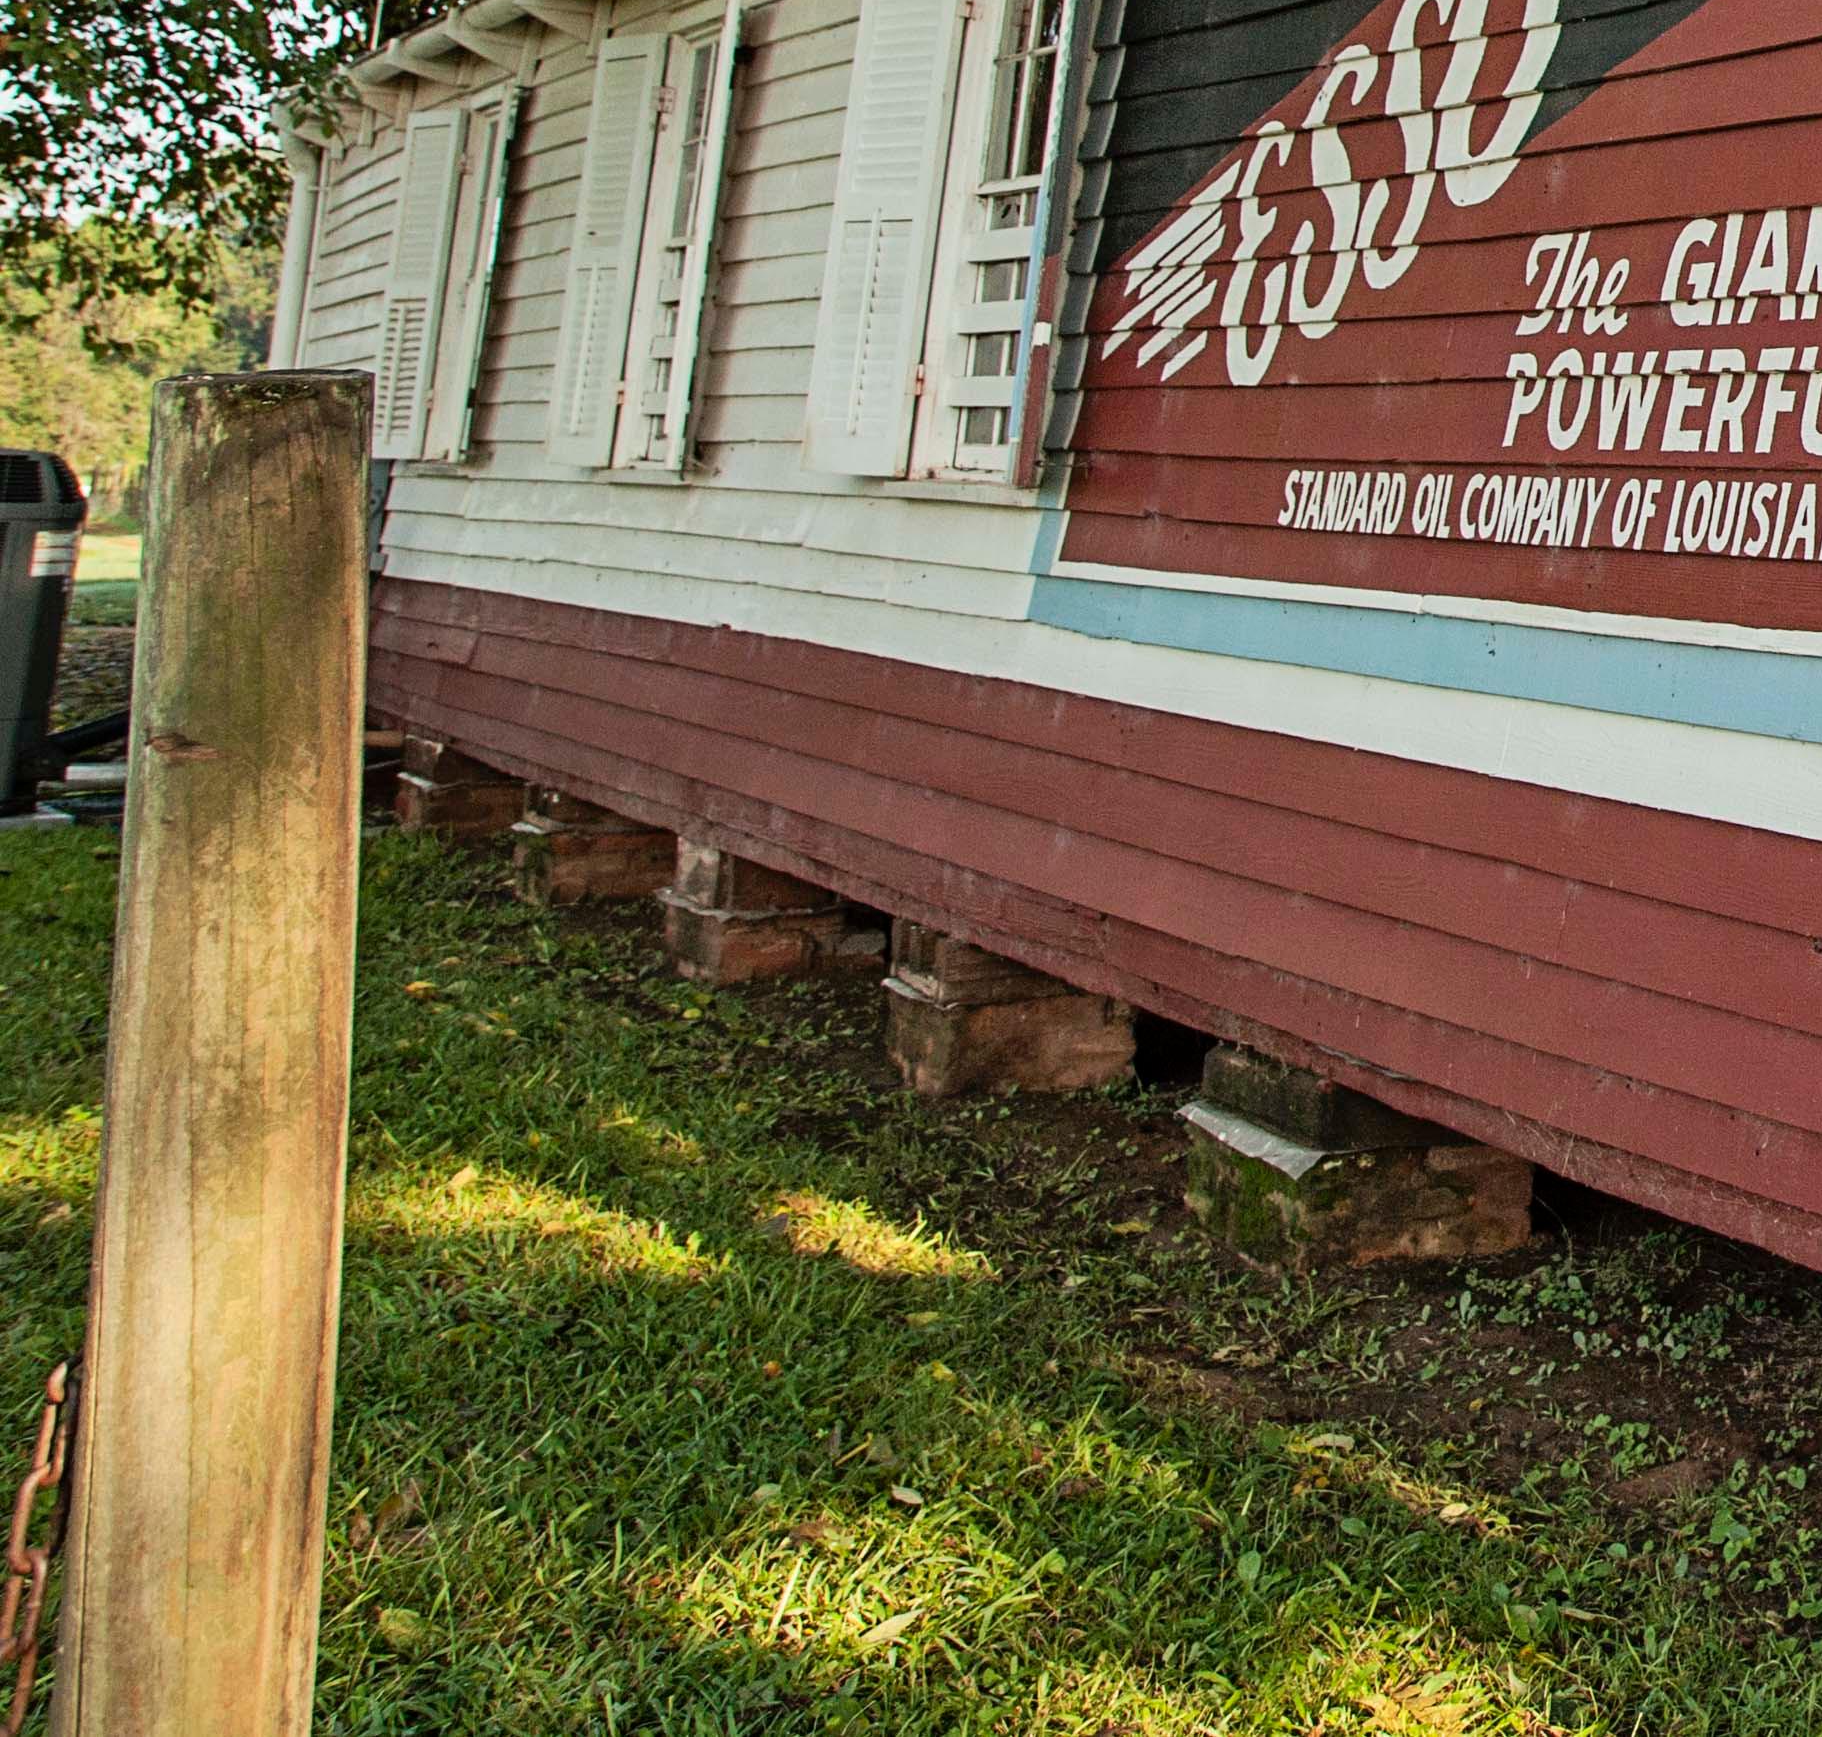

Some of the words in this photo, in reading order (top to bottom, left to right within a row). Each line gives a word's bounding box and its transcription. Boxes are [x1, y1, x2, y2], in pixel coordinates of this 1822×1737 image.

[1515, 230, 1630, 336] The
[1277, 469, 1407, 535] STANDARD
[1411, 473, 1454, 539] OIL
[1459, 473, 1611, 549] COMPANY
[1611, 478, 1663, 552] OF
